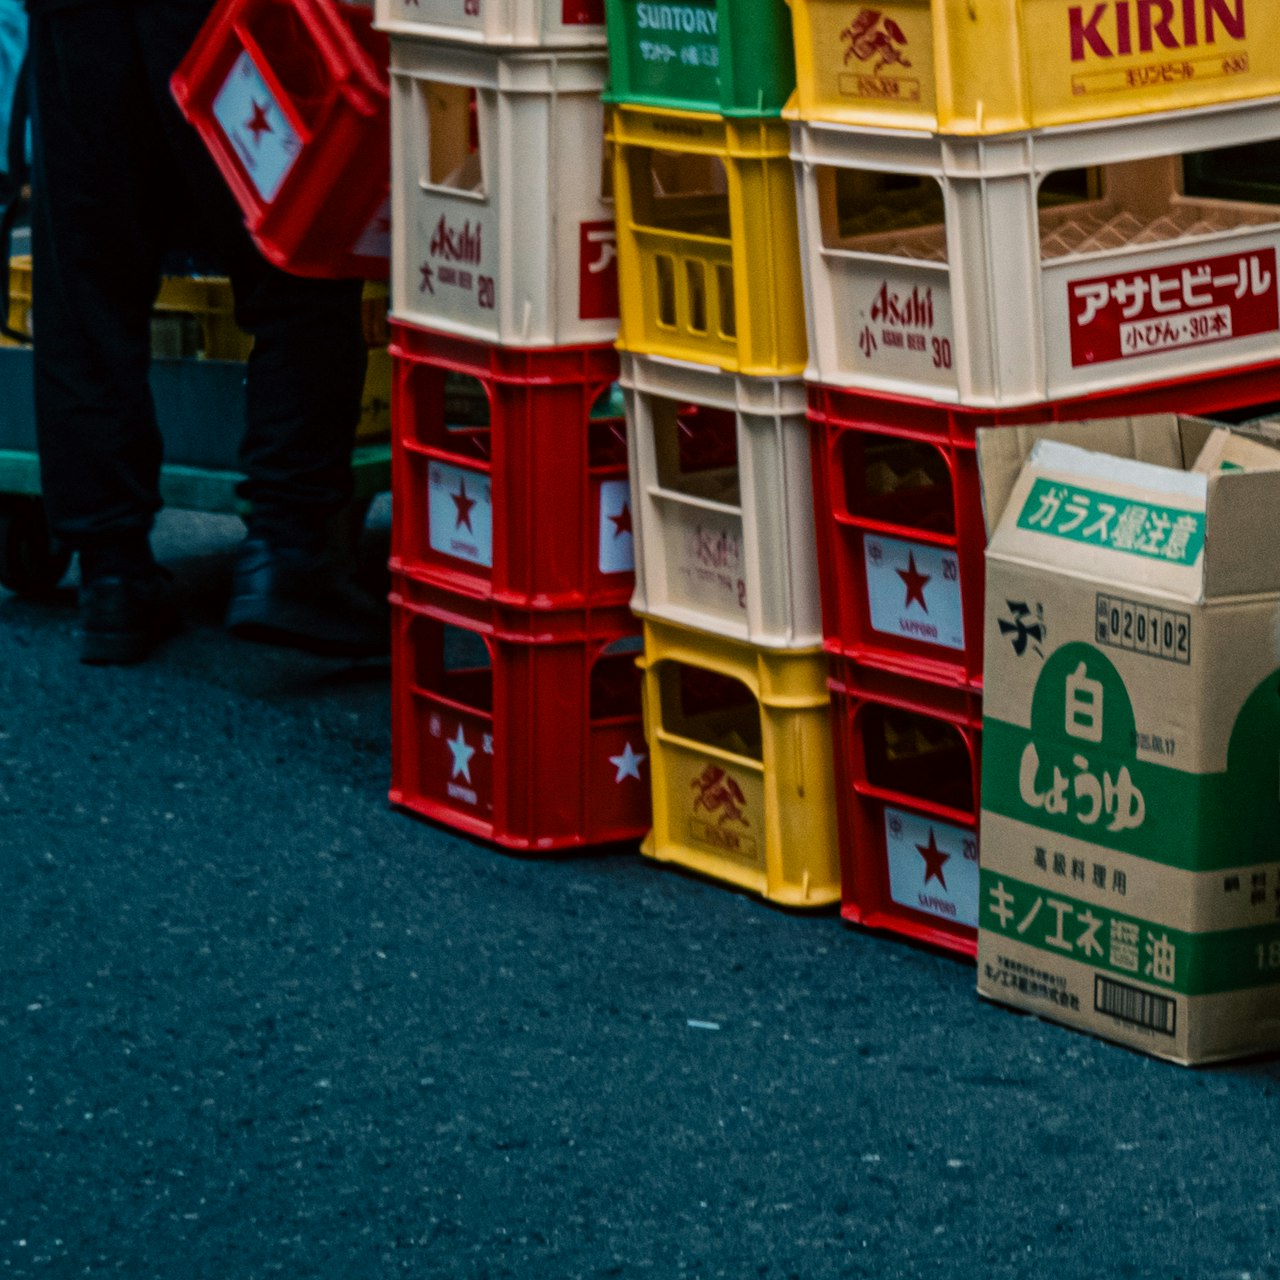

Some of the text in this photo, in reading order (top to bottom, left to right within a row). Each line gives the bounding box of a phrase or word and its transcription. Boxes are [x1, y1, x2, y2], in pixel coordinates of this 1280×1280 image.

[636, 2, 718, 34] SUNTORY
[431, 213, 482, 267] Asahi
[869, 282, 934, 329] Asahi
[1073, 257, 1271, 326] アサヒビール
[858, 326, 877, 359] 小
[932, 337, 952, 370] 30
[1110, 607, 1188, 653] 020102
[1064, 661, 1104, 744] 白
[1018, 741, 1147, 833] しょうゆ
[1032, 844, 1129, 897] 高級料理用
